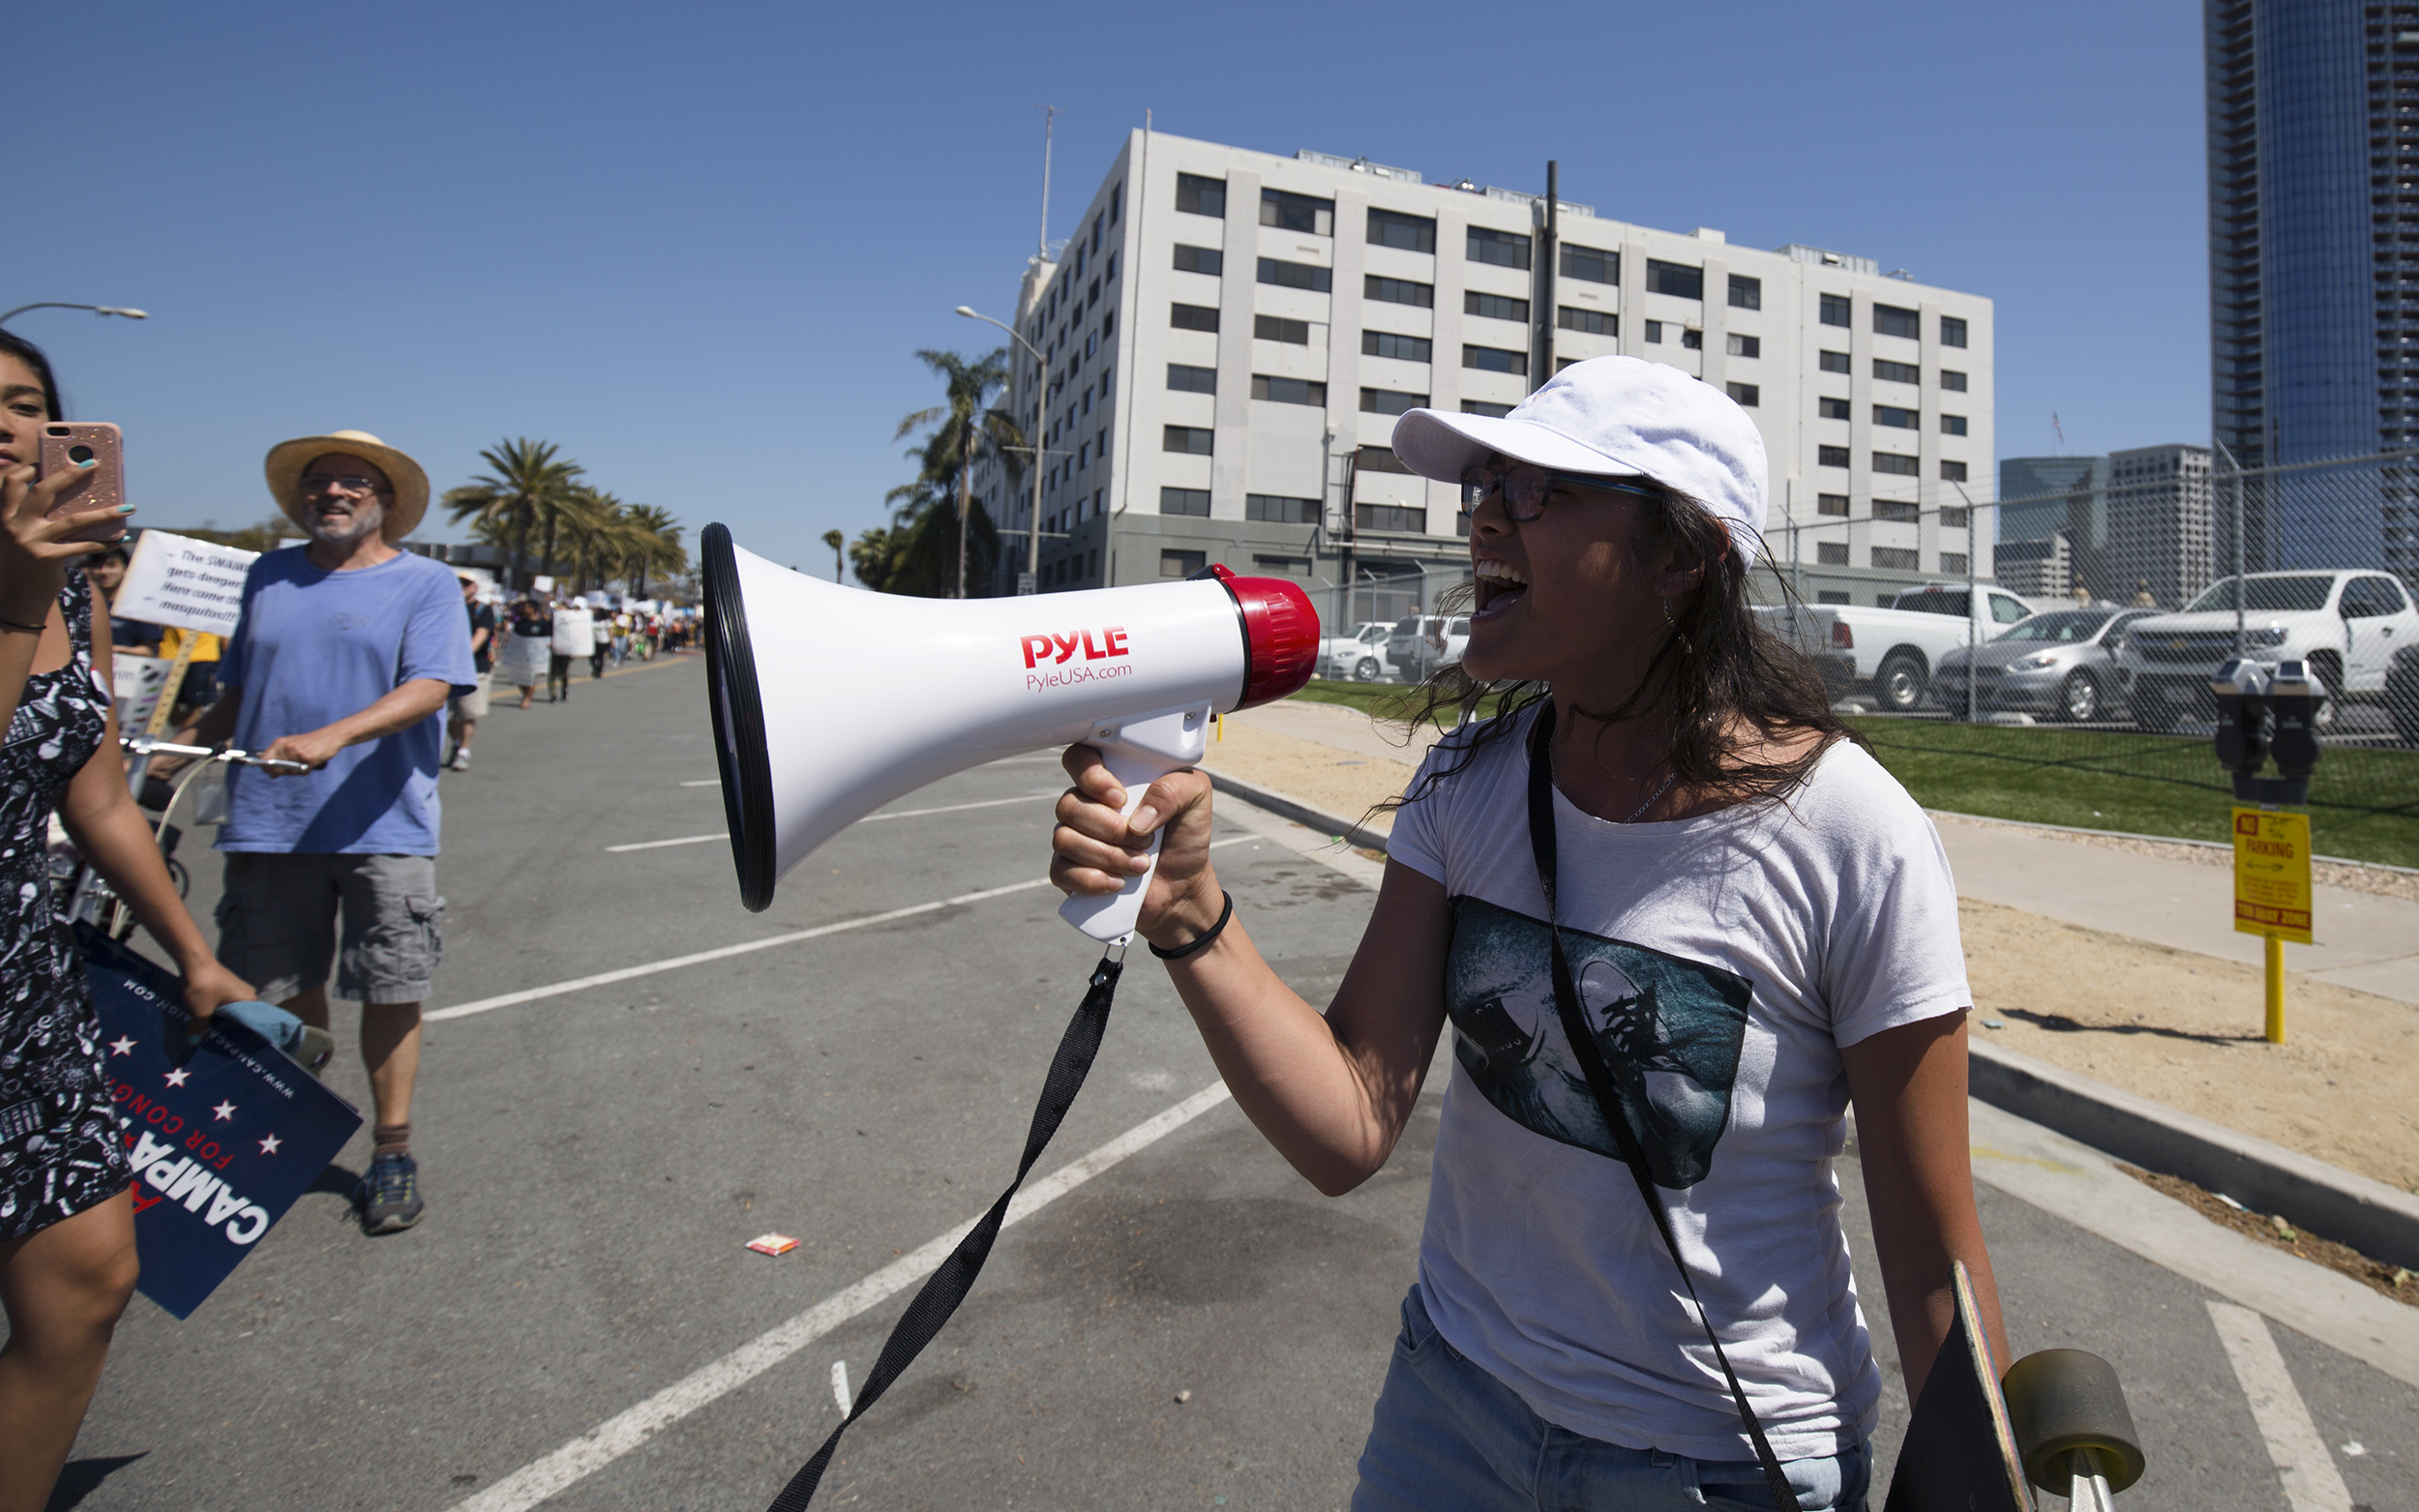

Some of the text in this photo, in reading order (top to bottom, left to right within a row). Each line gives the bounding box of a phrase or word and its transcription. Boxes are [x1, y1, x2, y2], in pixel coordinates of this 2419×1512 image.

[181, 549, 204, 563] The
[166, 567, 196, 580] gets
[160, 580, 243, 607] Here come th
[1020, 625, 1129, 669] PYLE
[1026, 665, 1132, 694] PyleUSA.com
[2241, 816, 2255, 833] NO
[2247, 838, 2294, 859] PARKING
[2282, 910, 2309, 928] ZONE
[123, 978, 295, 1100] WWW.CAMPACAAIGN.COM
[184, 1128, 234, 1170] FOR
